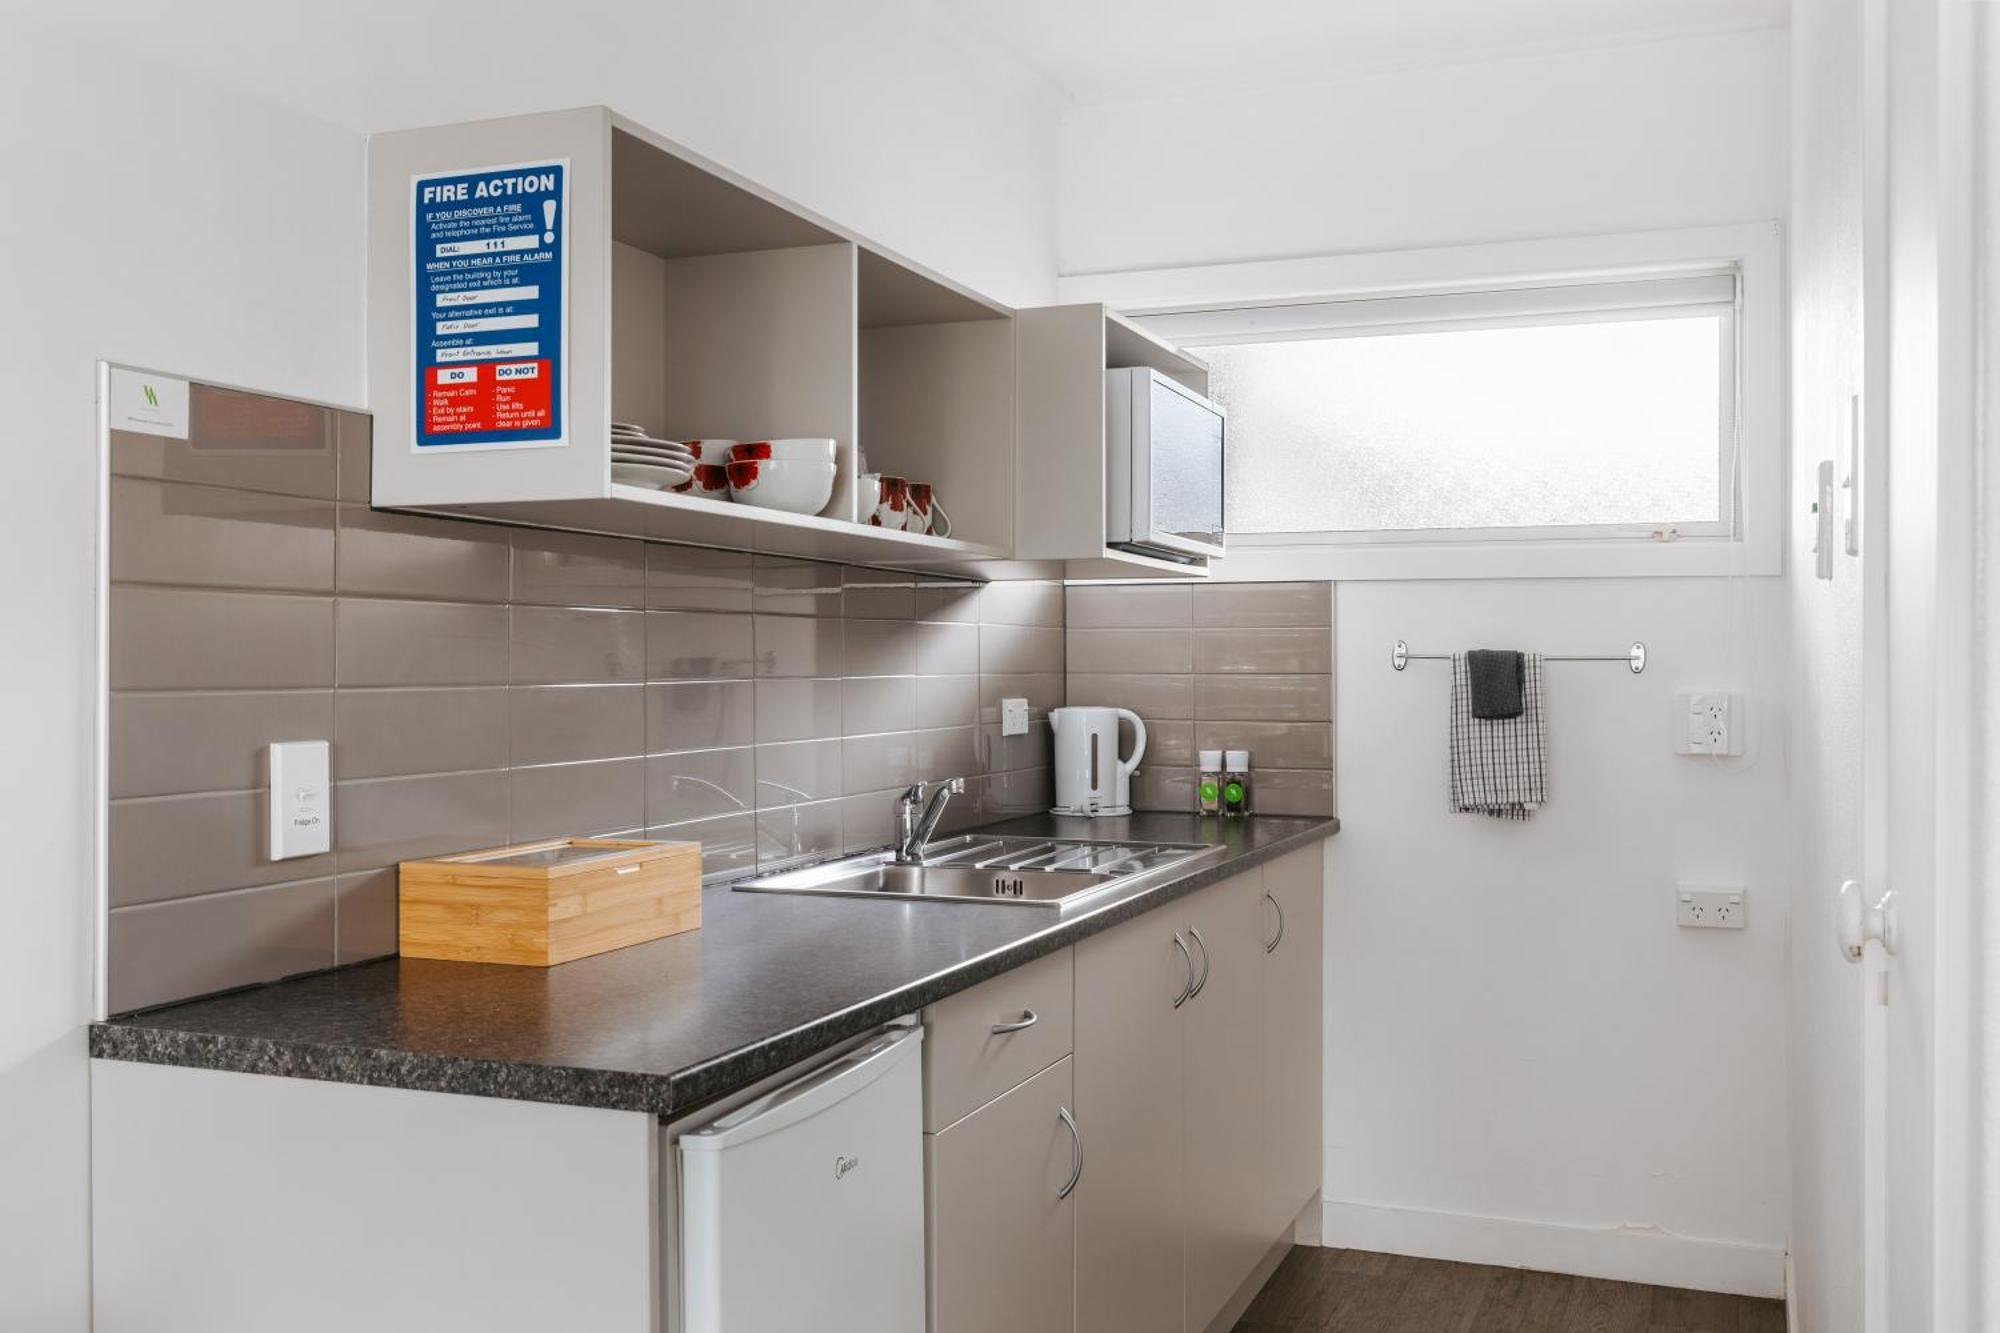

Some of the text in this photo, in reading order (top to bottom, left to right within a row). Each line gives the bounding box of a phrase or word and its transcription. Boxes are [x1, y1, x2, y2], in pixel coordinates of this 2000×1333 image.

[424, 174, 554, 204] FIRE ACTION
[436, 212, 452, 220] YOU
[454, 207, 494, 217] DISCOVER
[504, 204, 522, 212] FIRE
[430, 222, 458, 230] Activate
[459, 220, 470, 228] the
[472, 218, 498, 226] nearest
[512, 214, 532, 222] alarm
[430, 231, 443, 239] and
[444, 228, 479, 238] telephone
[508, 222, 534, 232] Service
[440, 246, 459, 254] DIAL:
[426, 262, 450, 270] WHEN
[452, 260, 469, 268] YOU
[471, 258, 493, 266] HEAR
[502, 254, 520, 264] FIRE
[523, 252, 552, 261] ALARM
[430, 270, 518, 283] Leave the building by your
[430, 282, 468, 292] designated
[469, 280, 480, 288] exit
[482, 278, 502, 286] which
[431, 311, 446, 319] Your
[448, 308, 482, 318] alternative
[431, 338, 464, 348] Assemble
[450, 371, 464, 380] DO
[498, 366, 536, 376] DO NOT
[432, 388, 476, 398] Remain Calm
[496, 386, 515, 394] Panic
[446, 406, 455, 414] by
[496, 409, 545, 419] Return until all
[432, 422, 481, 432] assembly point
[522, 419, 541, 428] given
